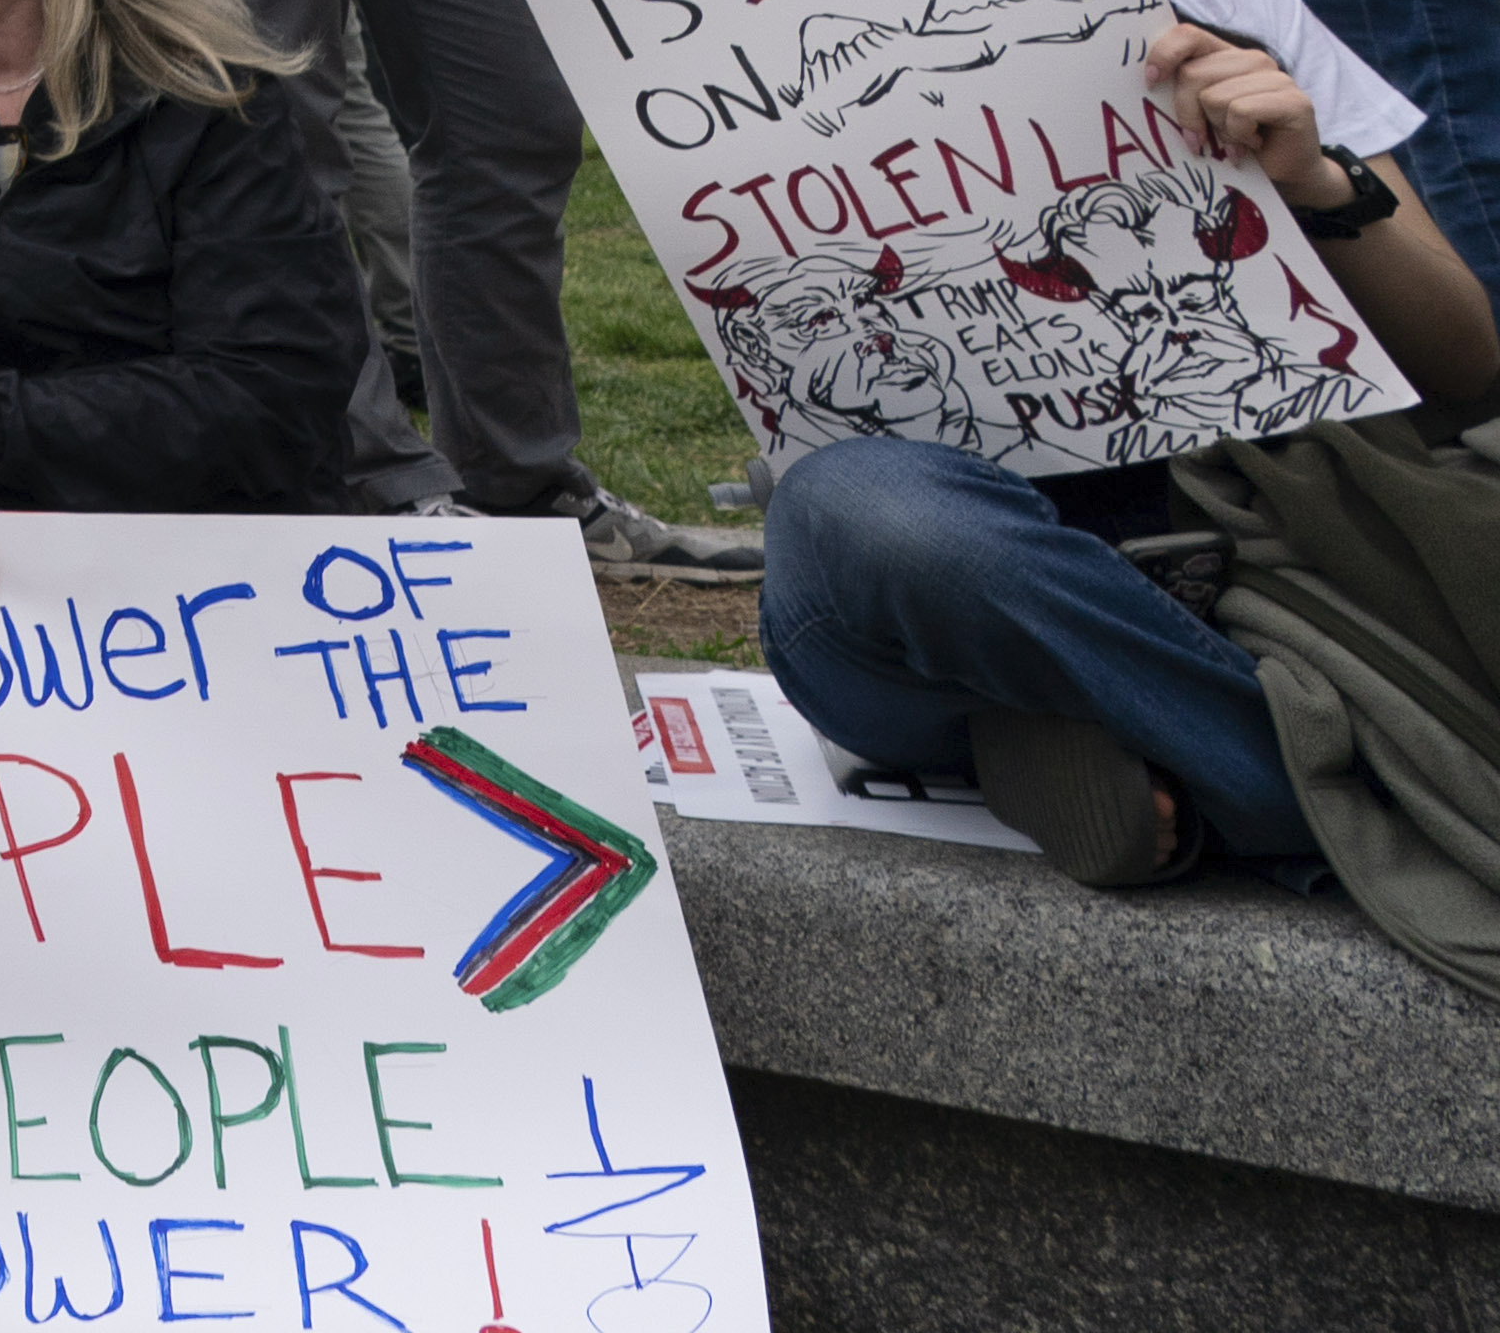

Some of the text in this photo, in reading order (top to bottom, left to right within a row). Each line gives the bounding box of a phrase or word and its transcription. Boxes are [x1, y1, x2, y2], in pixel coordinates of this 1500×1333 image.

[635, 44, 782, 149] ON
[682, 104, 1014, 277] STOLEN
[893, 277, 1026, 325] TRUMP
[303, 539, 472, 621] OF
[276, 628, 527, 727] THE
